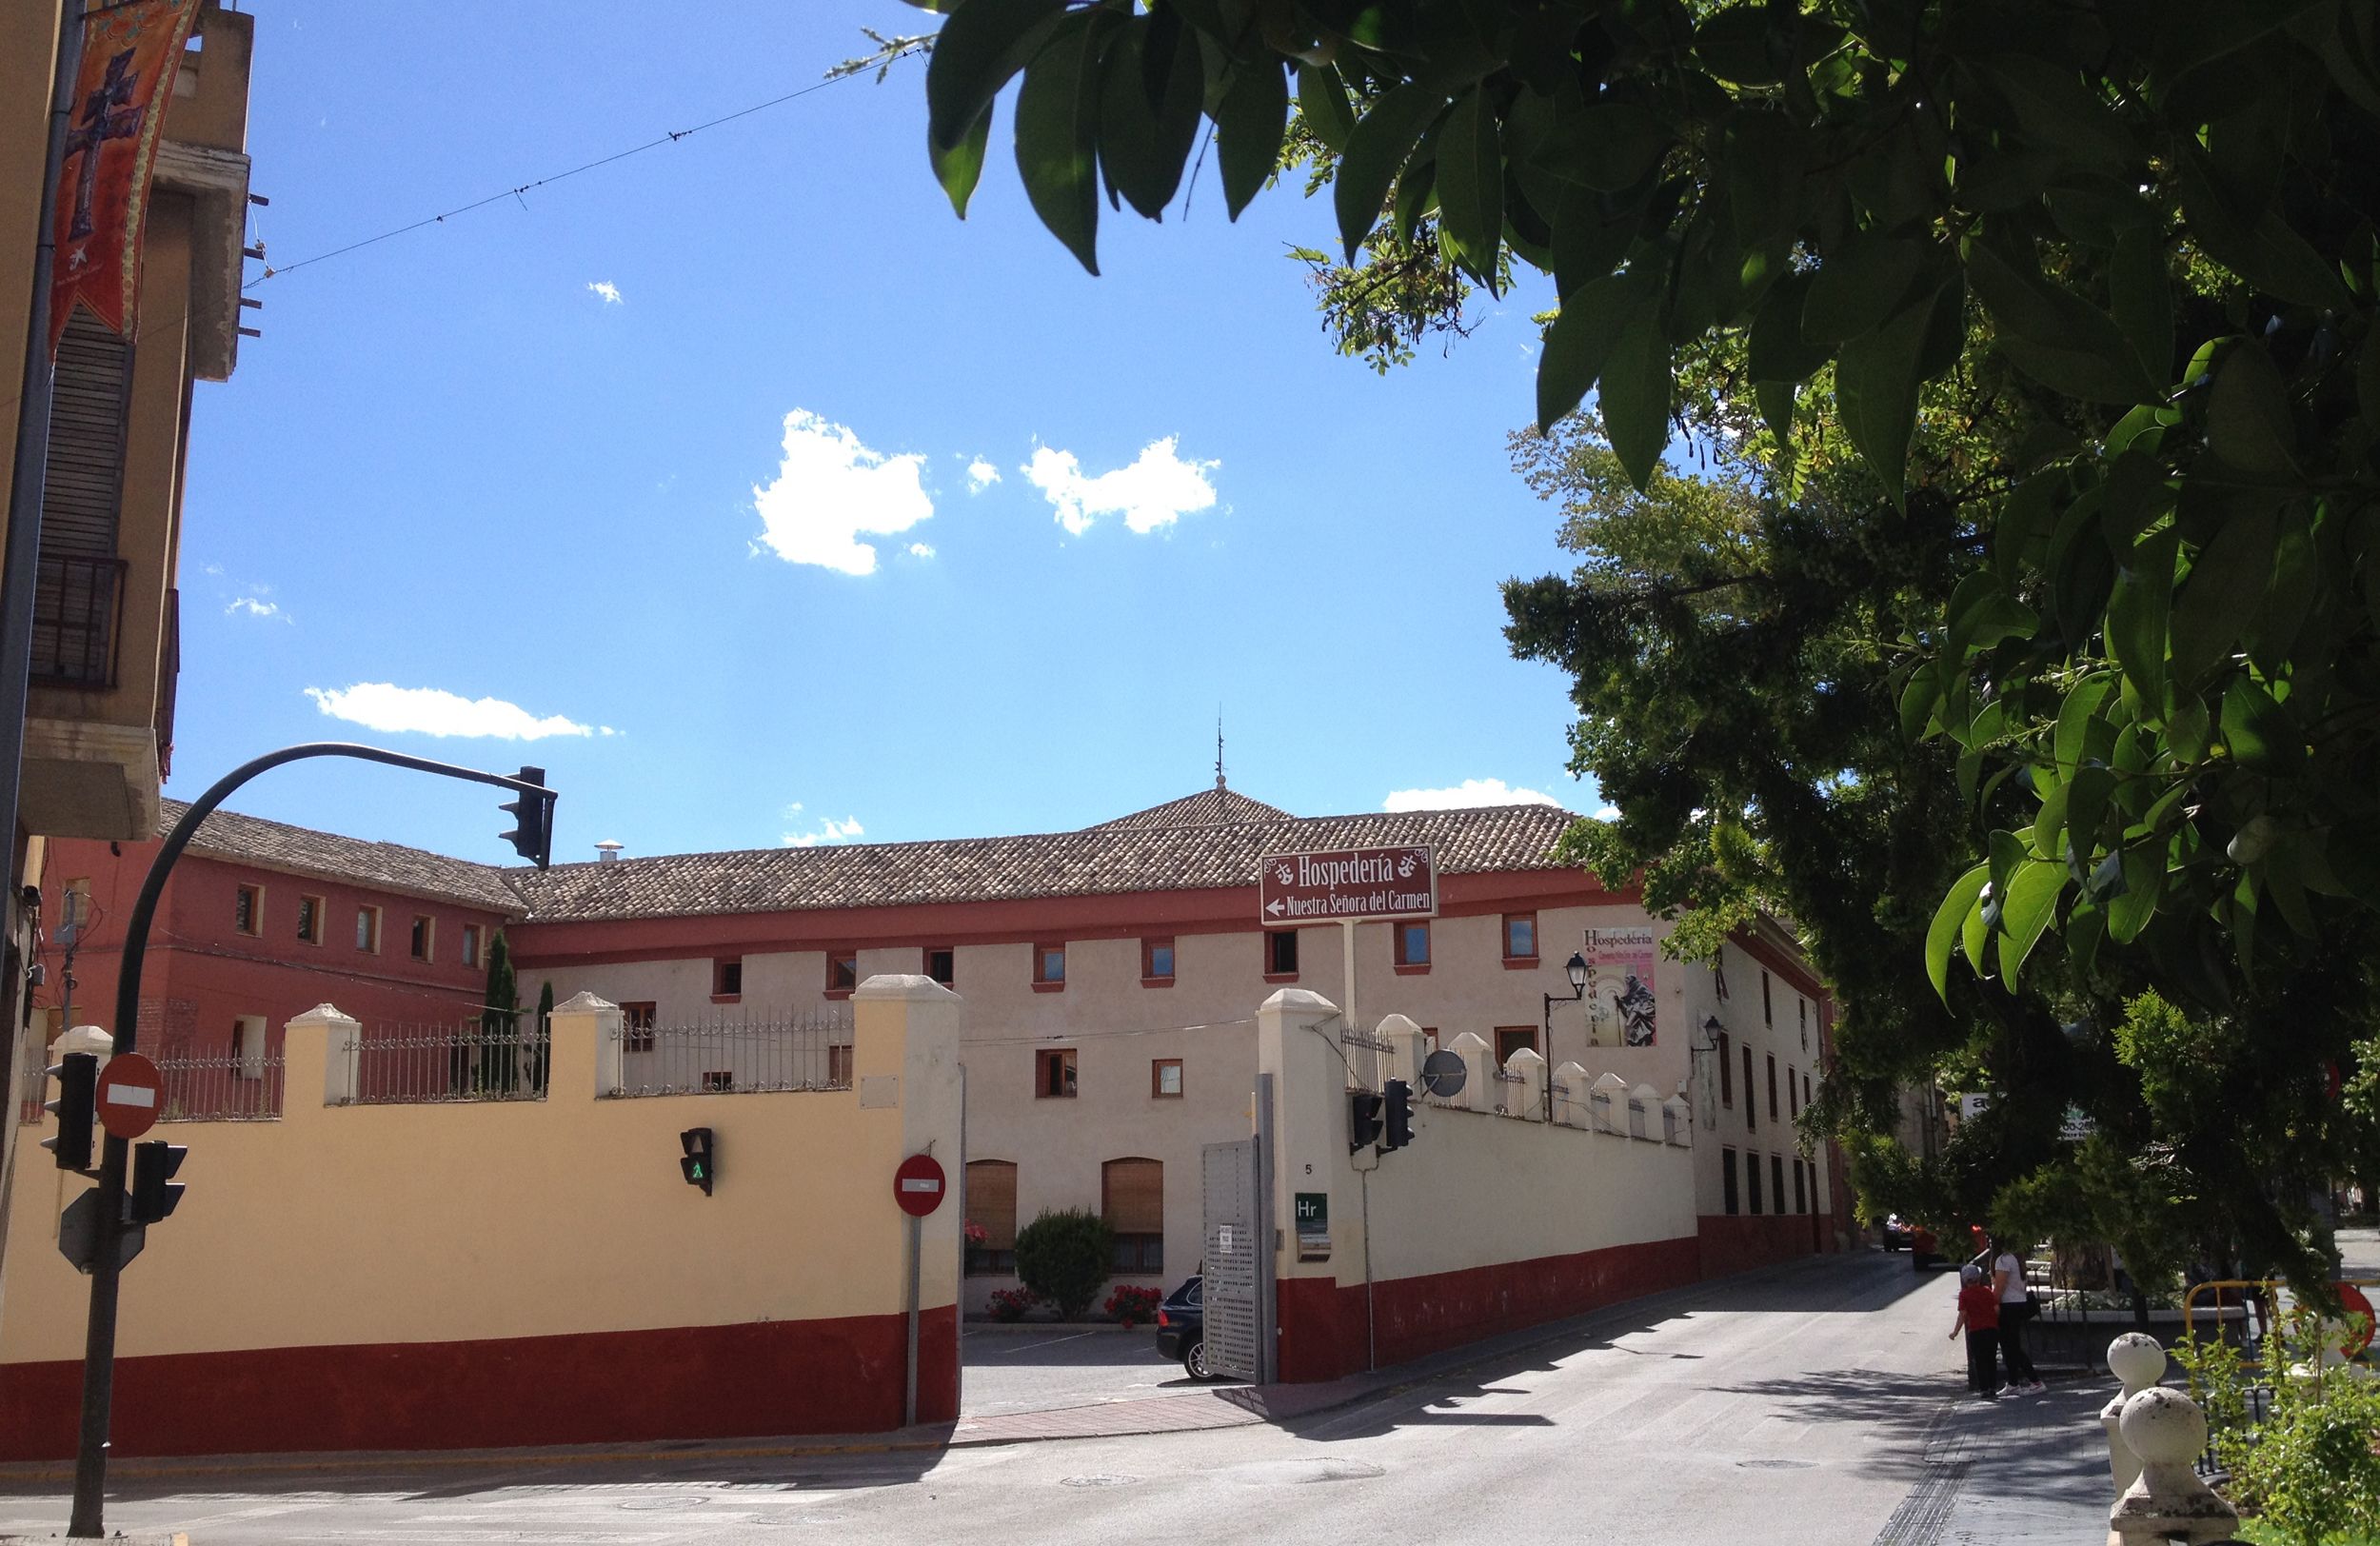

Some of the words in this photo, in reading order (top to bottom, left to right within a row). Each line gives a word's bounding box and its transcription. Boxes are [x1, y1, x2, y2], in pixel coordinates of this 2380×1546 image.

[1298, 853, 1394, 890] Hospedería
[1286, 896, 1328, 916] Nuestra
[1330, 893, 1366, 914] Señora
[1369, 891, 1386, 912] del
[1388, 890, 1431, 911] Carmen
[1305, 1163, 1313, 1175] 5
[1298, 1200, 1317, 1217] Hr
